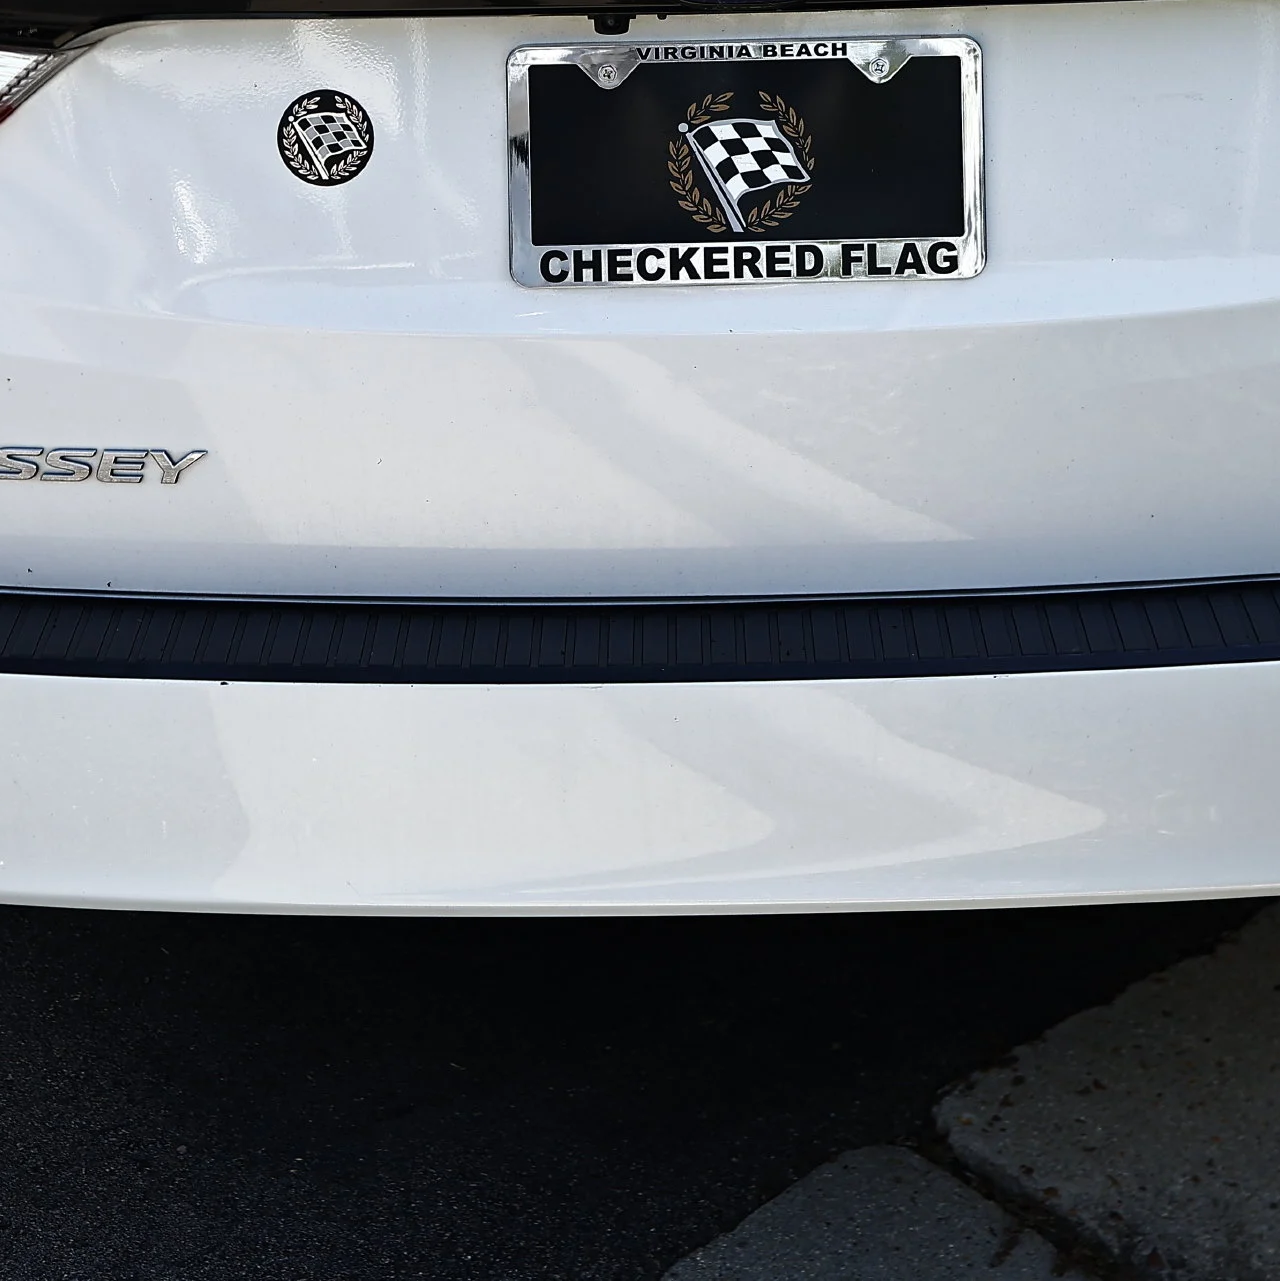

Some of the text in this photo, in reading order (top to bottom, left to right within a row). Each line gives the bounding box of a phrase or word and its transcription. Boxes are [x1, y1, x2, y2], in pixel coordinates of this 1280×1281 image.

[635, 42, 848, 61] VIRGINIA BEACH
[539, 241, 959, 283] CHECKERED FLAG
